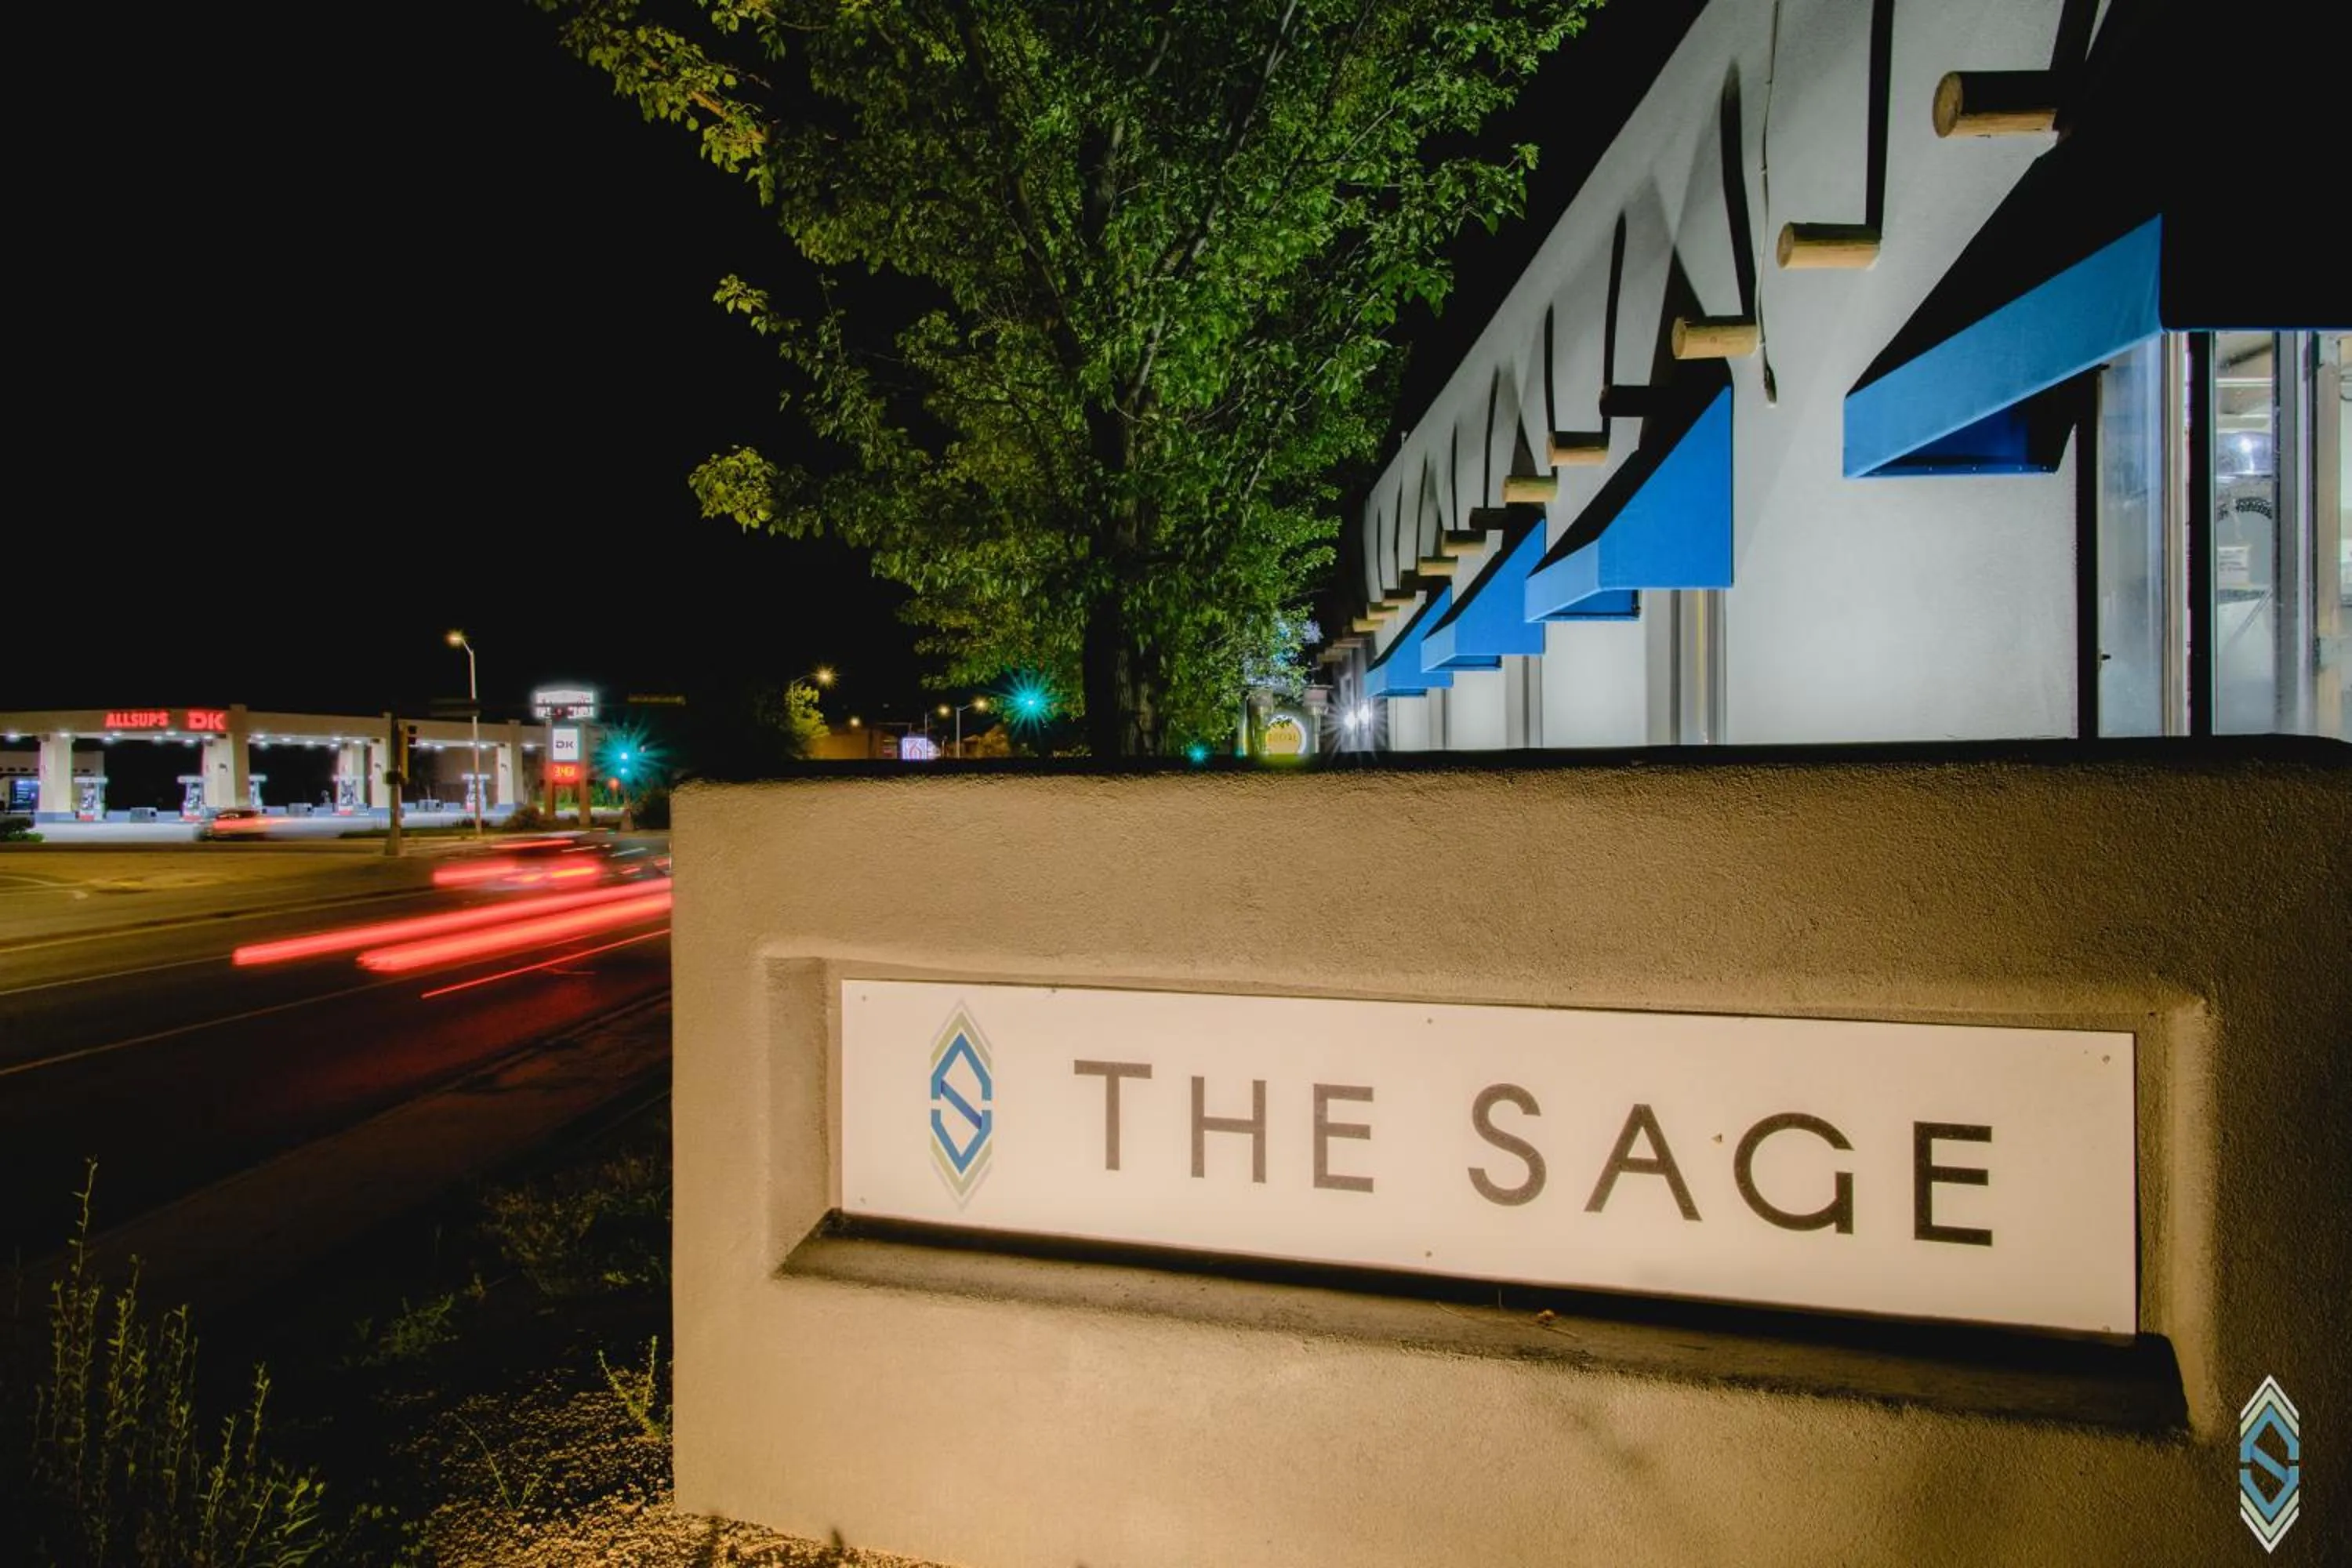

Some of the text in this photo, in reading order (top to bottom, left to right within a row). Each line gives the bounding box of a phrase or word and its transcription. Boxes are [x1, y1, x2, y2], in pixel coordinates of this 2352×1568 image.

[187, 711, 226, 730] DK
[555, 740, 574, 749] DK
[1074, 1059, 1993, 1247] THE SAGE
